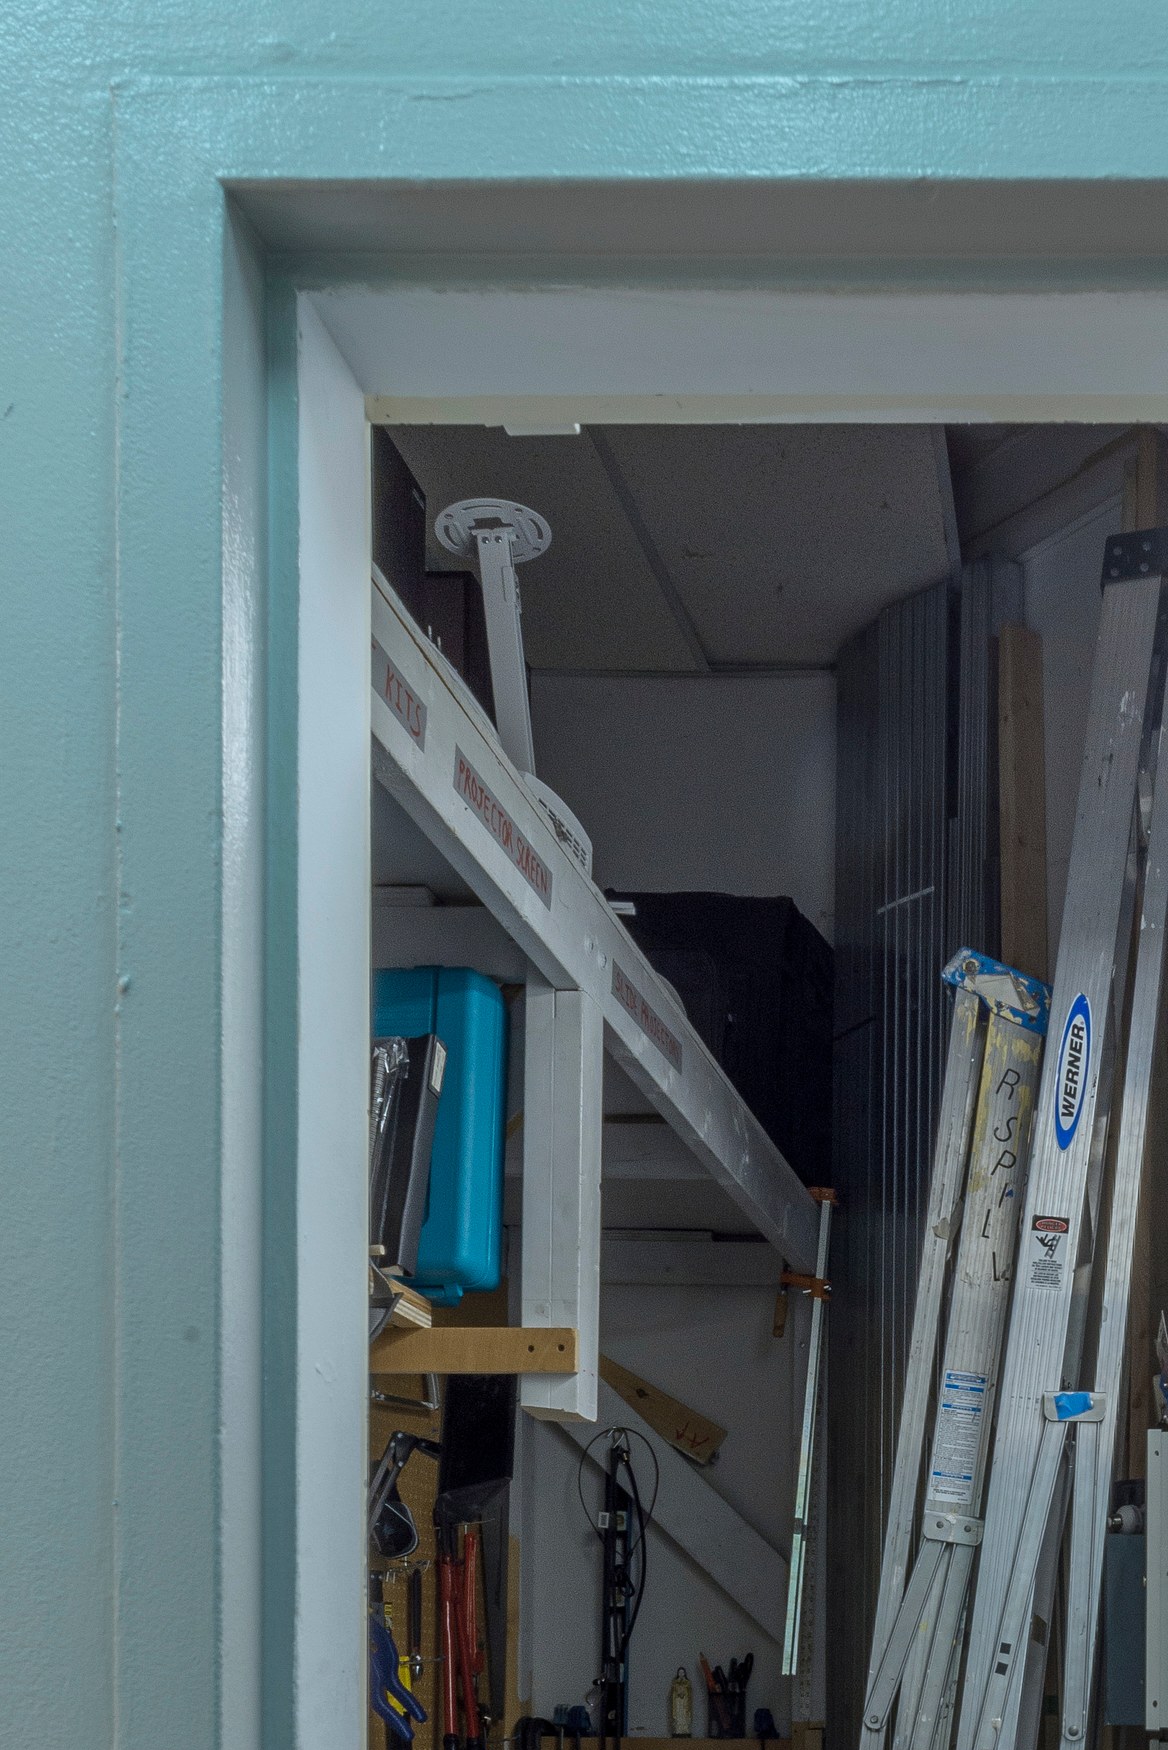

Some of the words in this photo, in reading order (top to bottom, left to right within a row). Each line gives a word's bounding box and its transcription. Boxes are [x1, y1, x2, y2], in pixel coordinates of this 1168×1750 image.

[385, 664, 421, 737] KITS
[457, 759, 513, 854] PROJECTOR
[516, 837, 549, 894] SCREEN
[1061, 1022, 1085, 1118] WERNER
